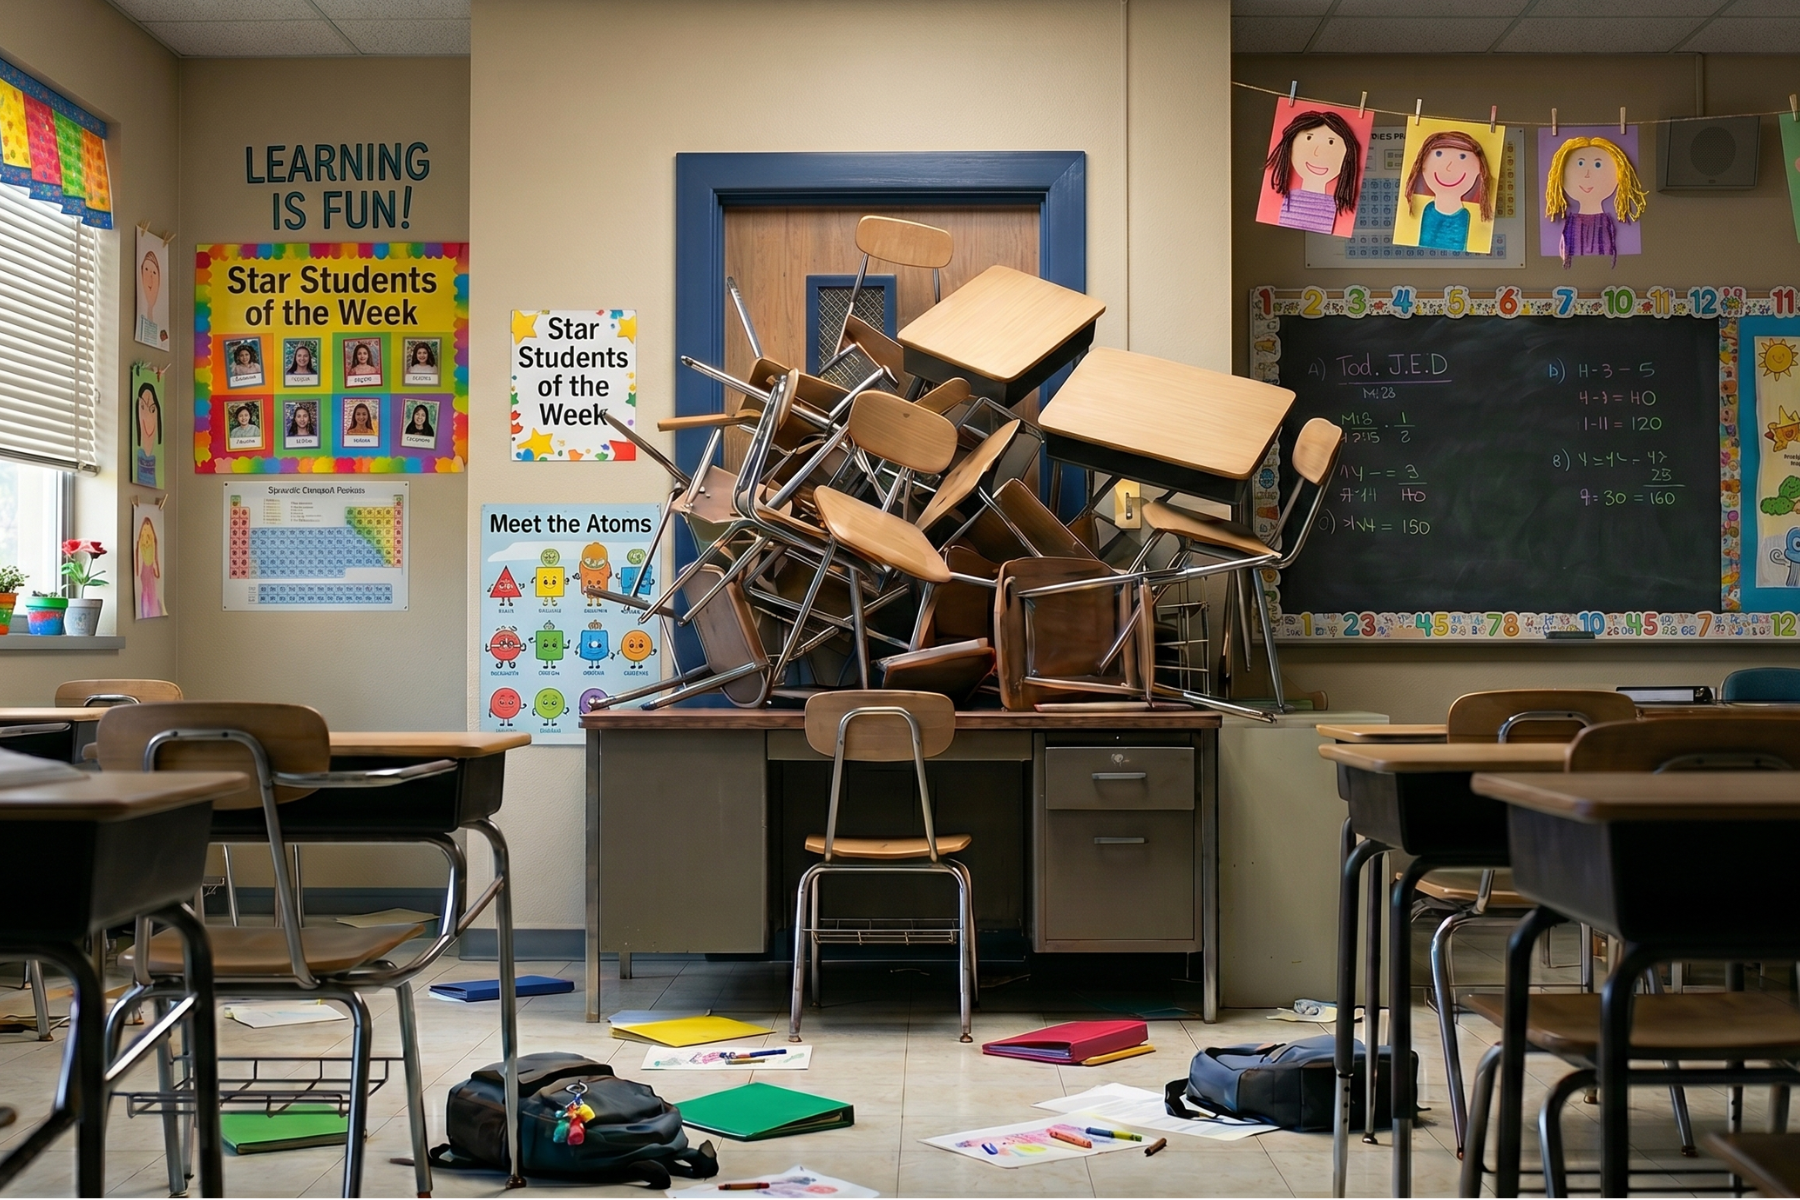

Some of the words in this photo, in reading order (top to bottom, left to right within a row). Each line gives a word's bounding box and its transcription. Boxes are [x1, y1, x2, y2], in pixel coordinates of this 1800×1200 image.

[246, 142, 430, 183] LEARNING
[273, 191, 306, 230] IS
[323, 186, 412, 229] FUN!
[227, 265, 291, 294] Star
[300, 265, 437, 294] Students
[245, 299, 275, 326] of
[283, 299, 329, 326] the
[338, 299, 418, 326] Week
[1259, 288, 1271, 316] 1
[1304, 289, 1323, 316] 2
[1348, 288, 1367, 315] 3
[1392, 289, 1413, 315] 4
[1447, 289, 1465, 315] 5
[1499, 288, 1518, 316] 6
[1556, 289, 1574, 316] 7
[1604, 289, 1633, 315] 10
[1650, 289, 1670, 315] 11
[1690, 289, 1718, 315] 12
[1772, 289, 1795, 315] 11
[548, 317, 600, 340] Star
[519, 346, 629, 368] Students
[538, 374, 563, 397] of
[569, 374, 609, 397] the
[539, 403, 609, 426] Week
[490, 514, 542, 533] Meet
[547, 514, 580, 533] the
[586, 513, 652, 533] Atoms
[1301, 613, 1312, 636] 1
[1579, 612, 1606, 636] 10
[1697, 612, 1713, 637] 7
[1771, 612, 1797, 637] 12
